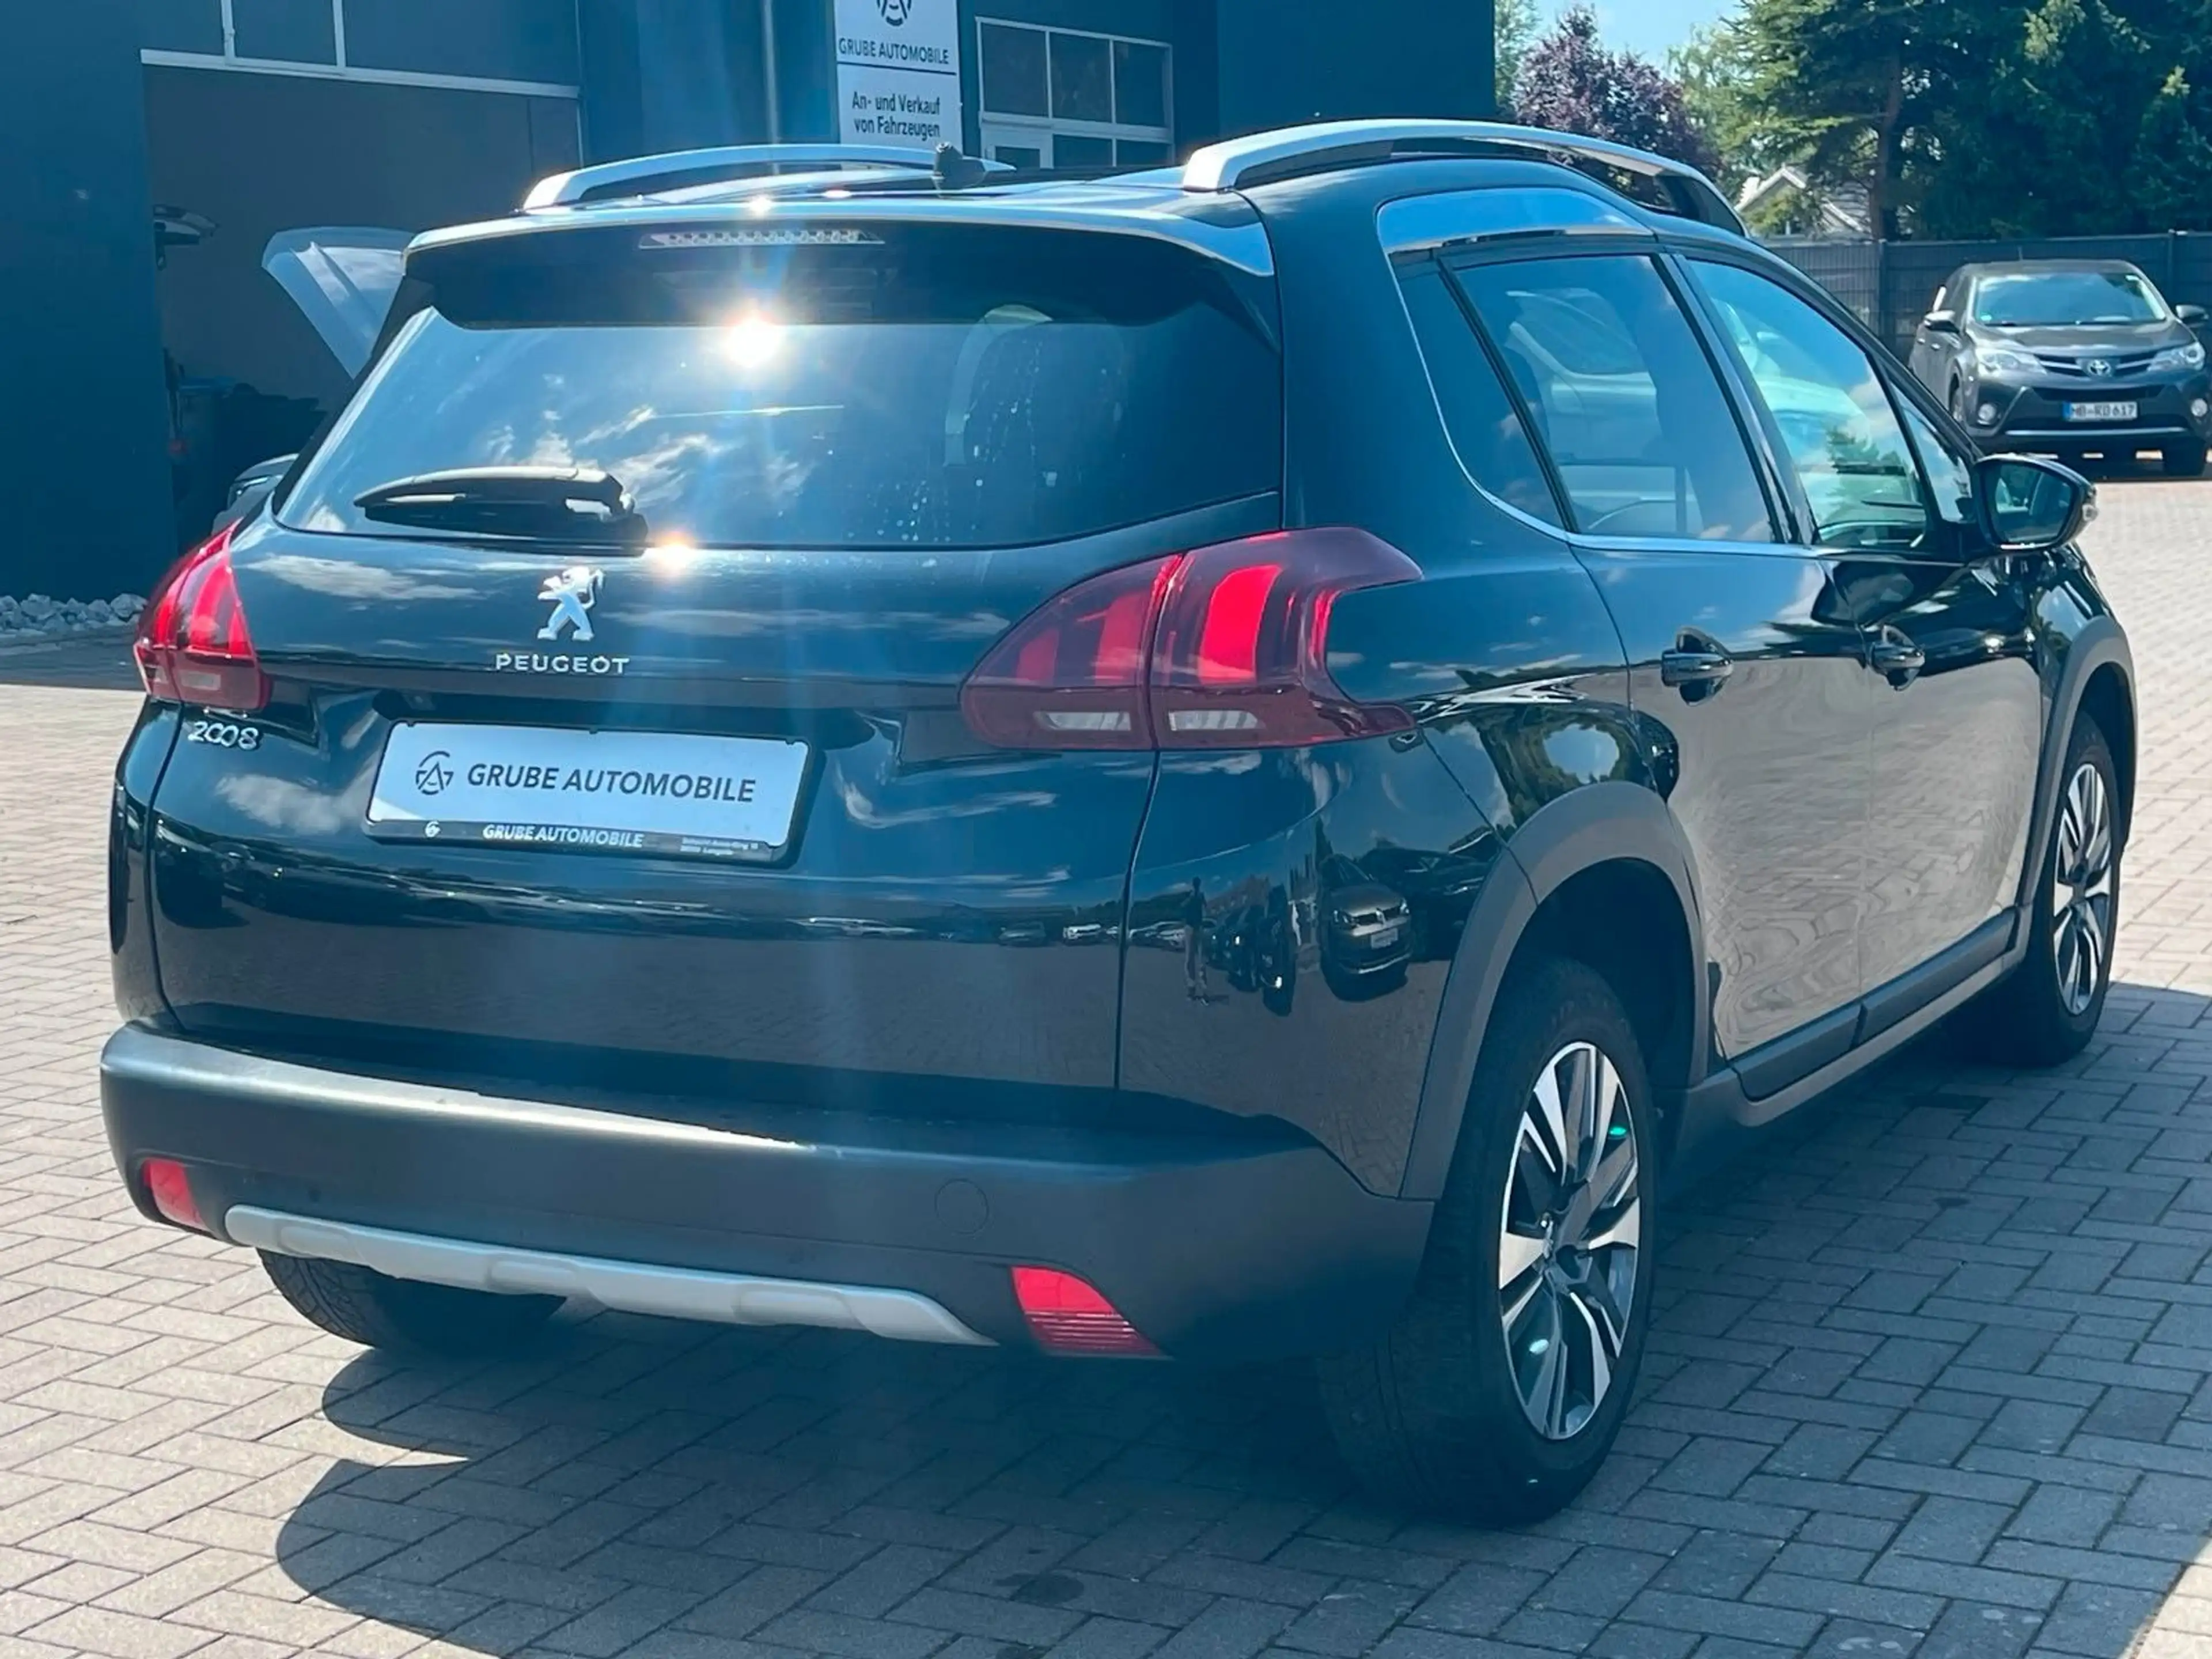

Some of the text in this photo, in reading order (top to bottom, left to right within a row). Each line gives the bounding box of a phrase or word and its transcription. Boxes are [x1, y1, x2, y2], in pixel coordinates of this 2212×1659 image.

[839, 37, 950, 65] GRUBE AUTOMOBILE
[852, 91, 941, 115] An- und Verkauf
[854, 116, 941, 141] von Fahrzeugen
[495, 653, 630, 674] PEUGEOT
[187, 721, 259, 750] 2008
[467, 763, 756, 802] GRUBE AUTOMOBILE
[482, 824, 645, 848] GRUBE AUTOMOBILE
